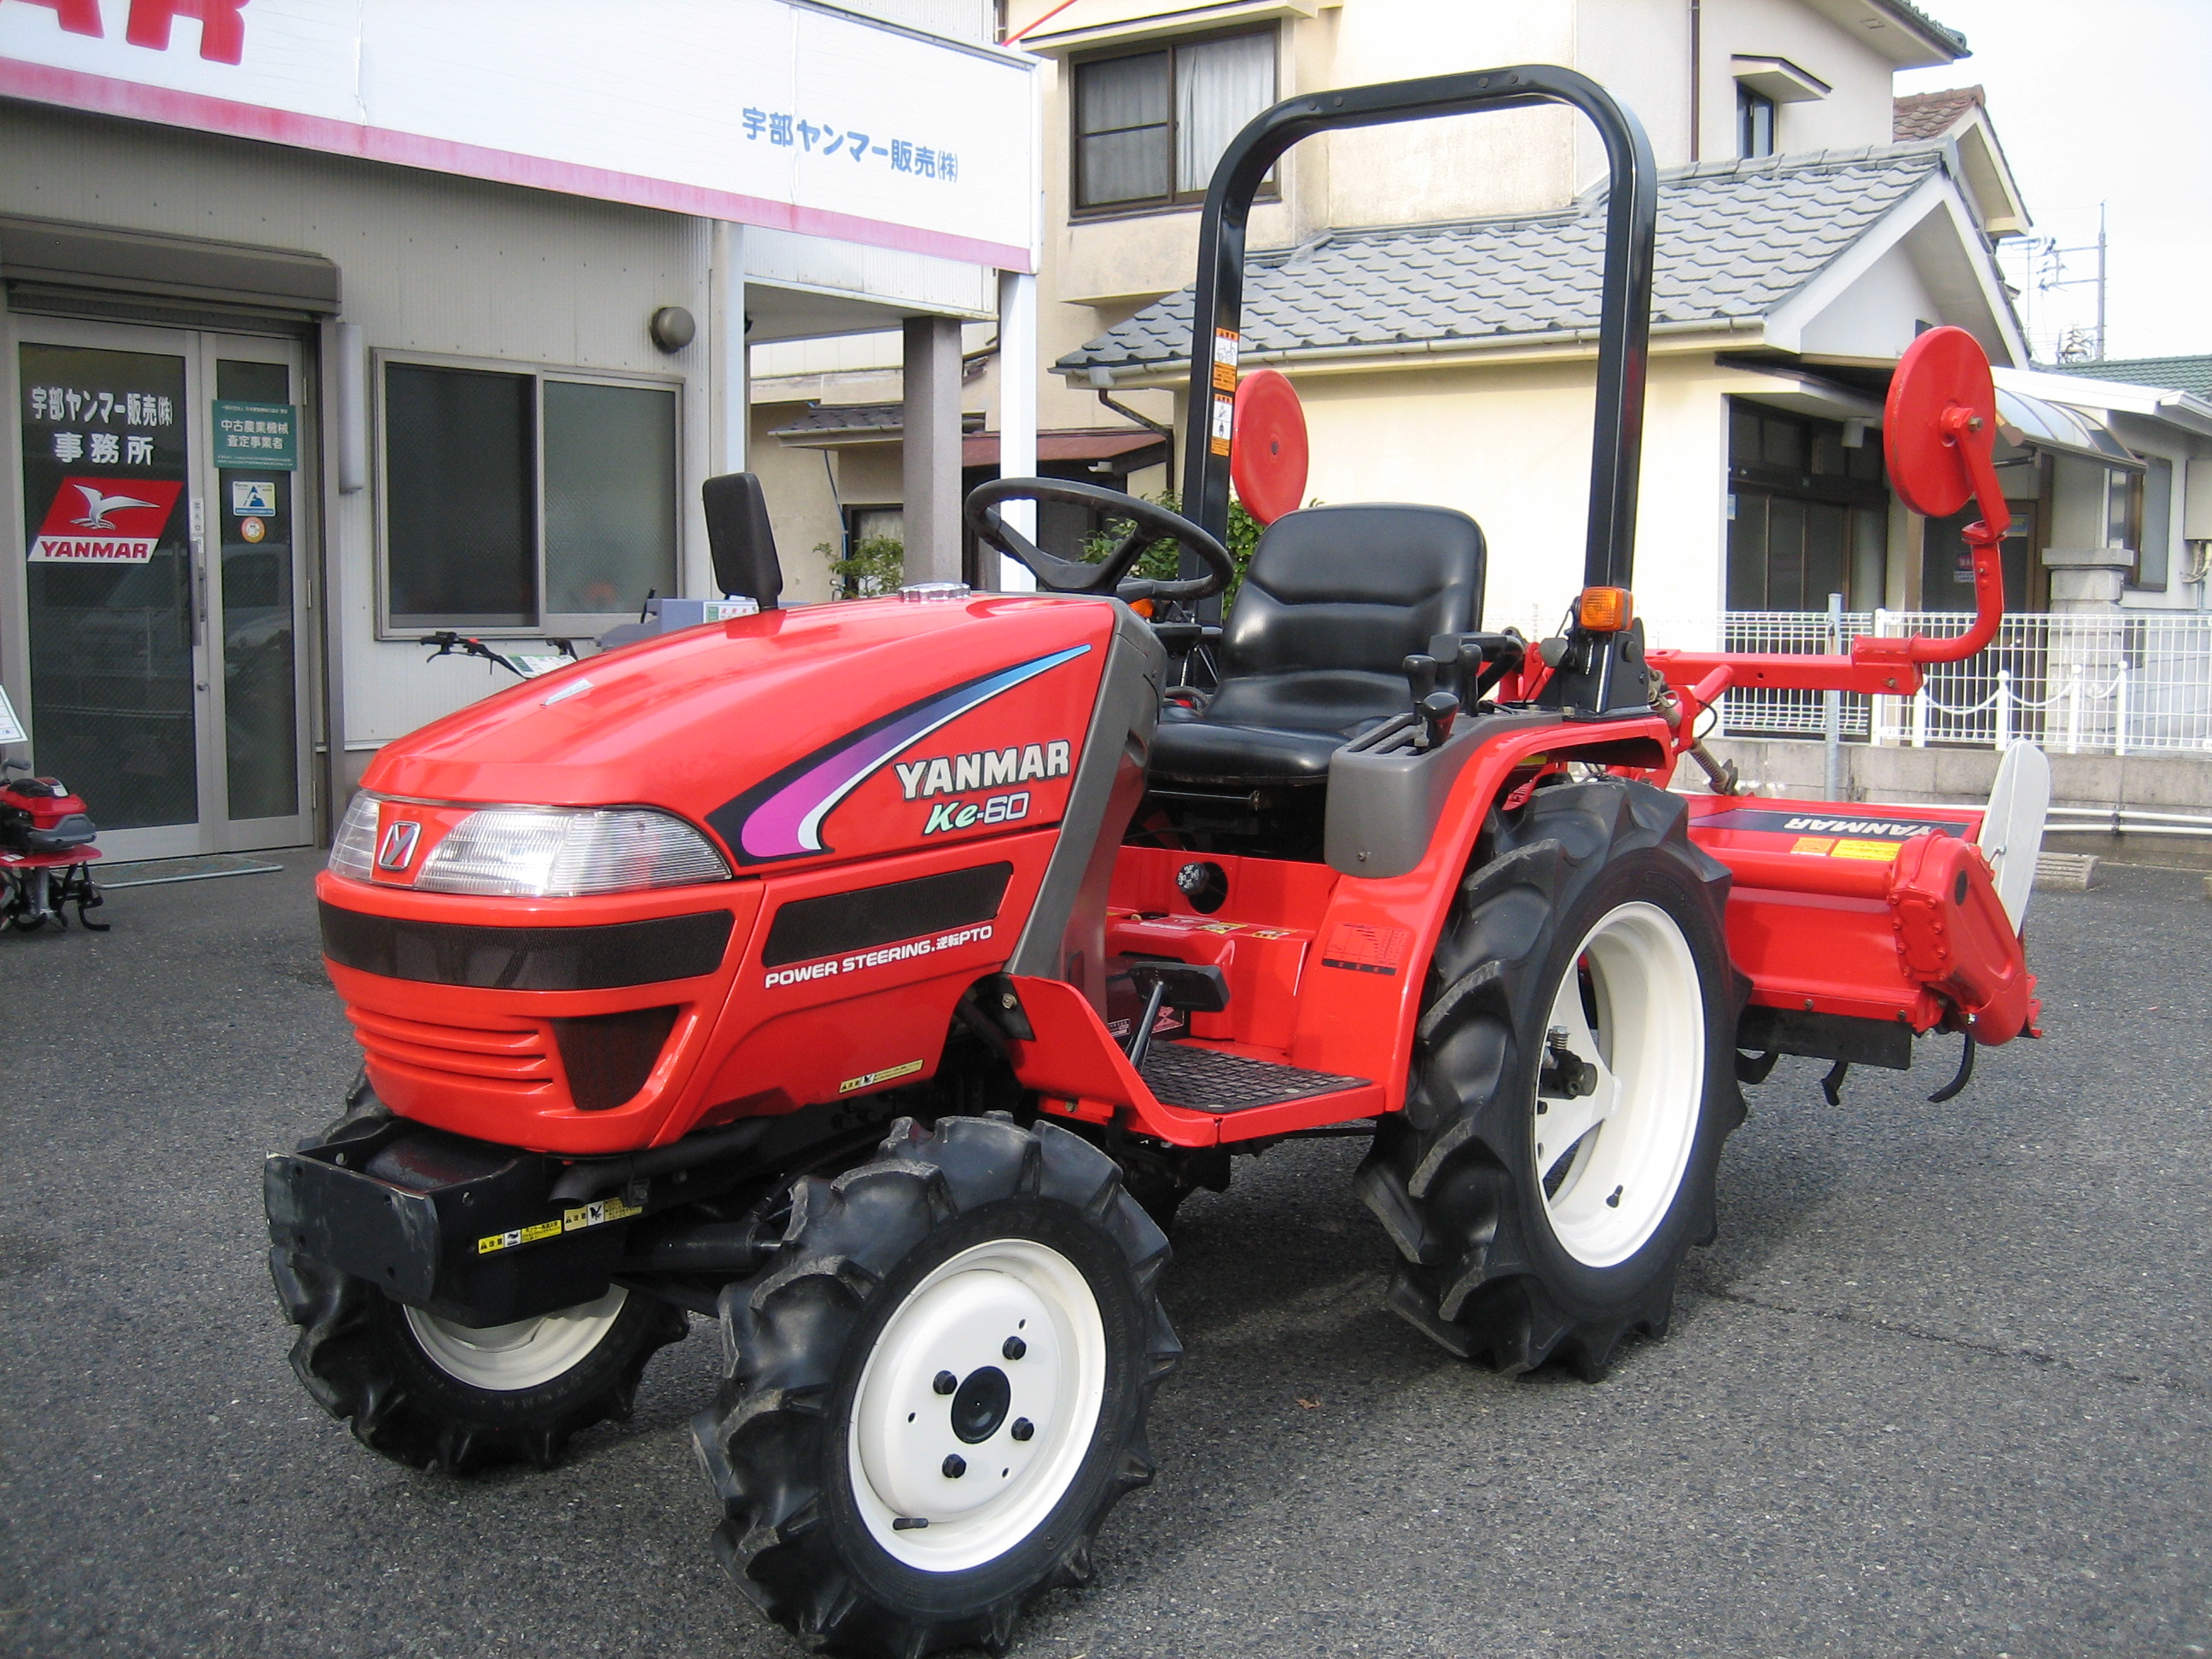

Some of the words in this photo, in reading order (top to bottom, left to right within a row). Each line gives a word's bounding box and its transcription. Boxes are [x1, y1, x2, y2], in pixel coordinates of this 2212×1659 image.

[53, 431, 154, 466] 事務所
[41, 541, 148, 558] YANMAR
[895, 739, 1070, 800] YANMAR
[1784, 818, 1931, 836] YANMAR
[765, 961, 838, 989] POWER
